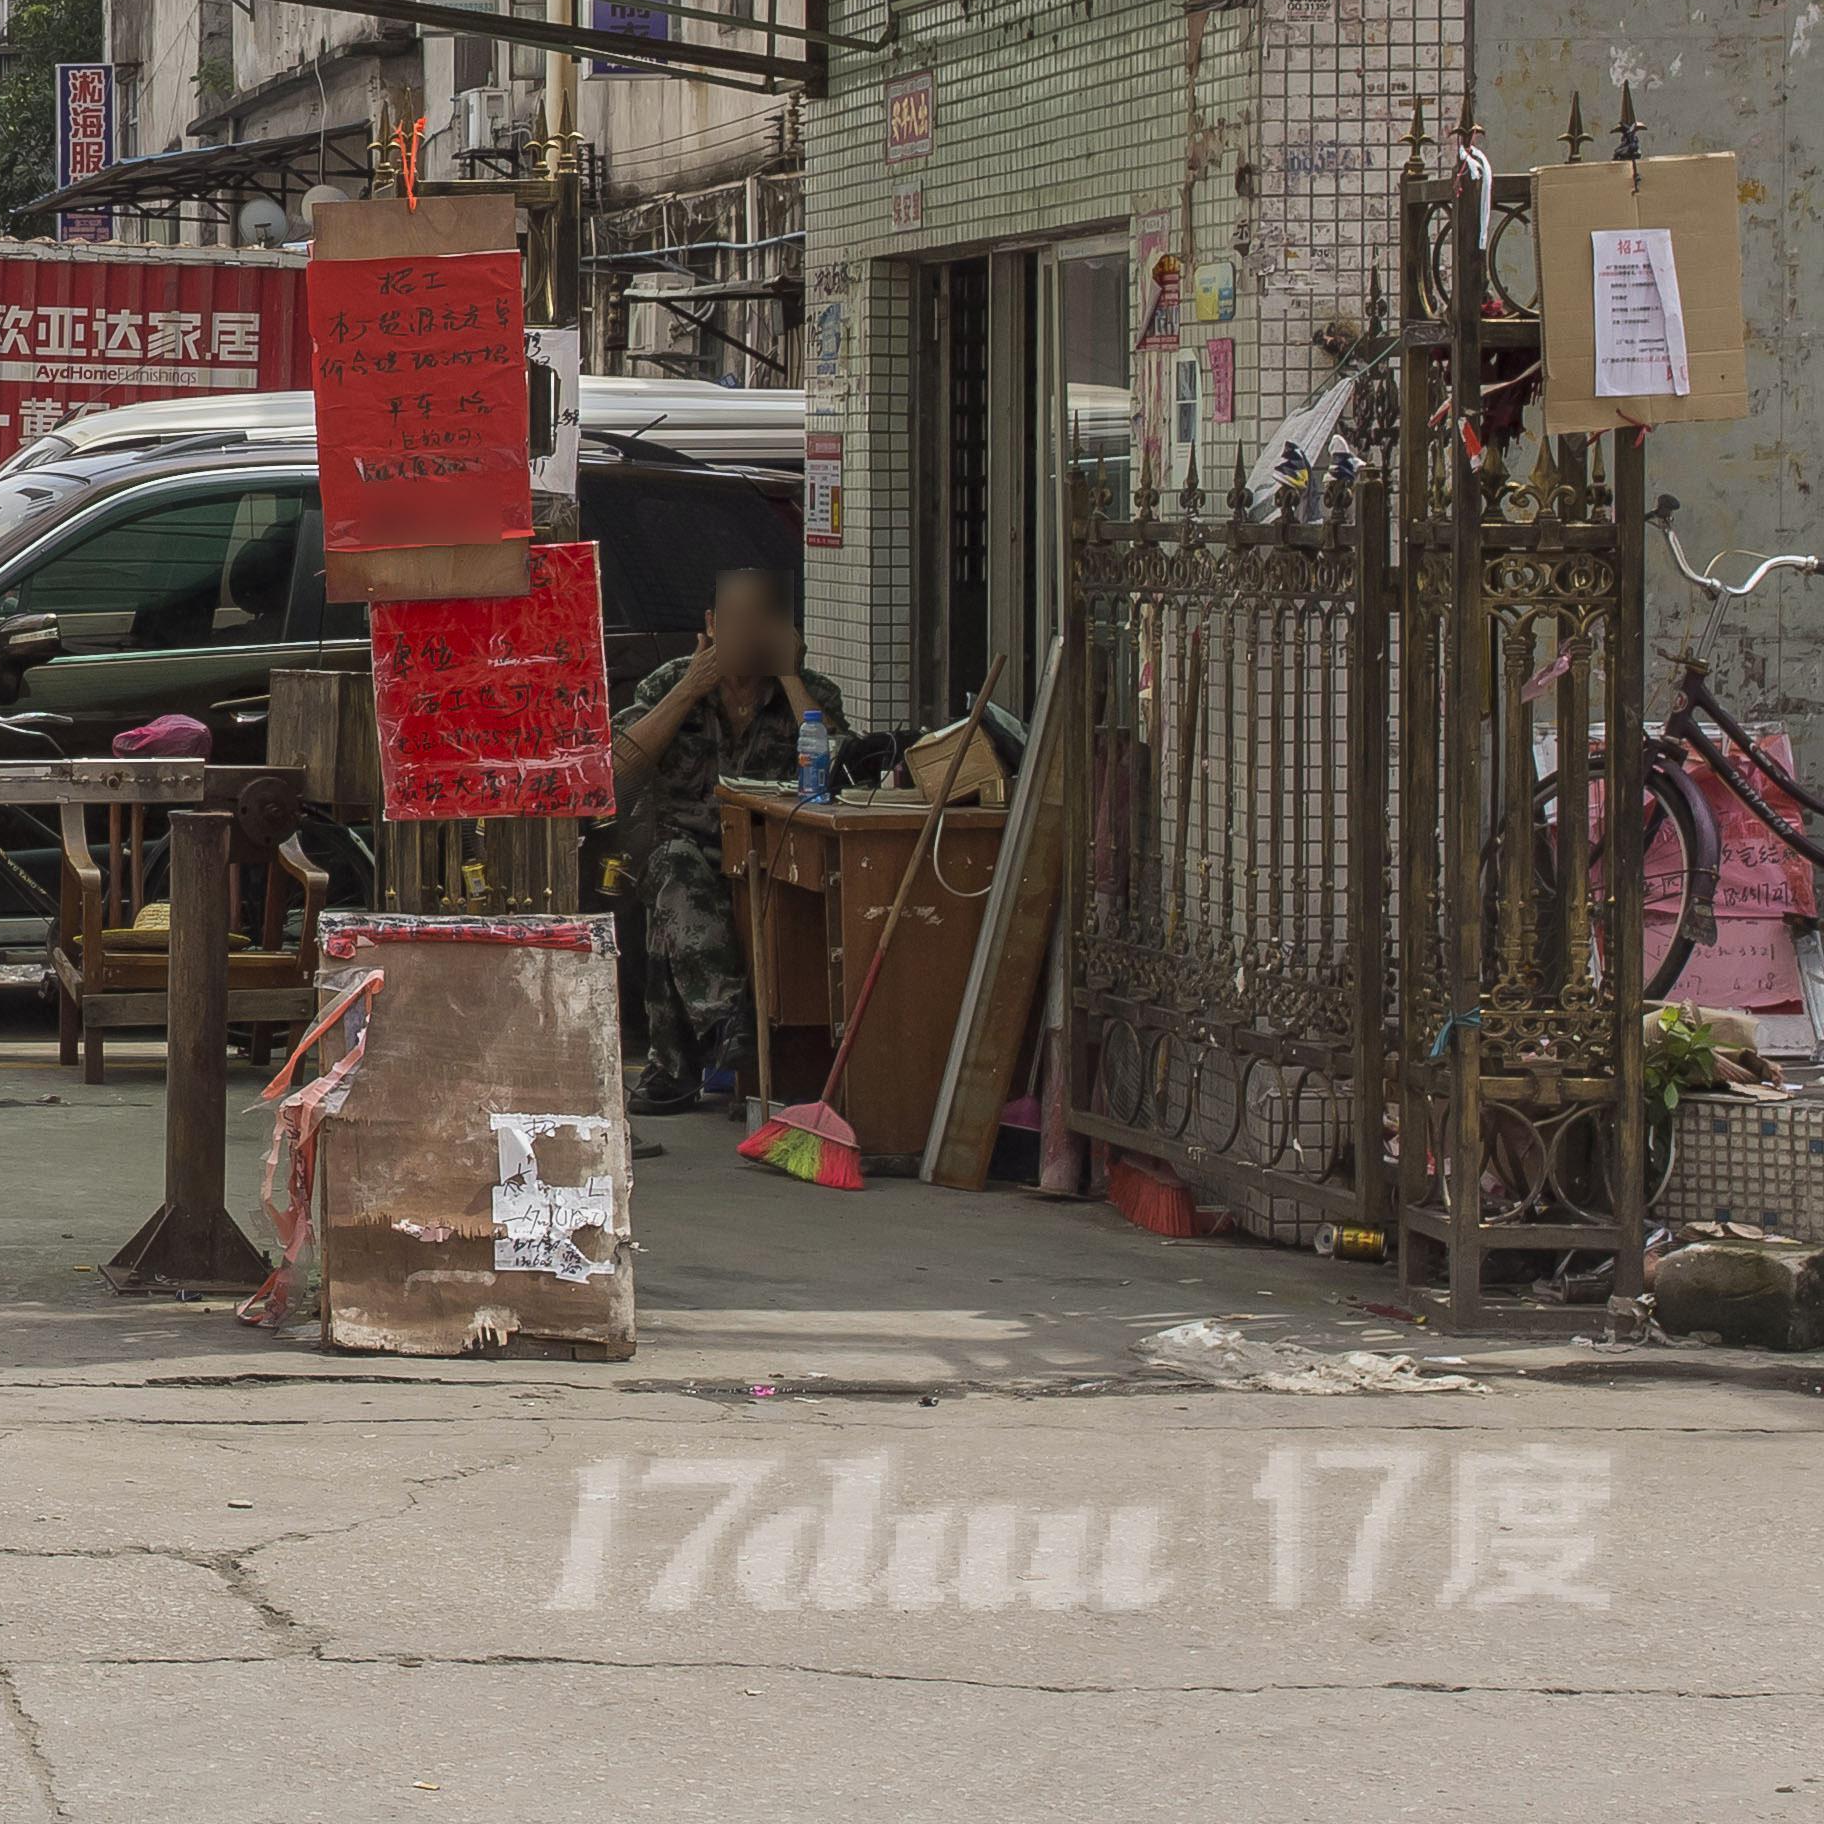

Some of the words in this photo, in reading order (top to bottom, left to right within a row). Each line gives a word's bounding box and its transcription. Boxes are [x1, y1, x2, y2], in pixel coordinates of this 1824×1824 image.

[1617, 238, 1647, 255] 招工
[377, 267, 446, 295] 招工
[35, 364, 198, 386] AydHomeFurnishings
